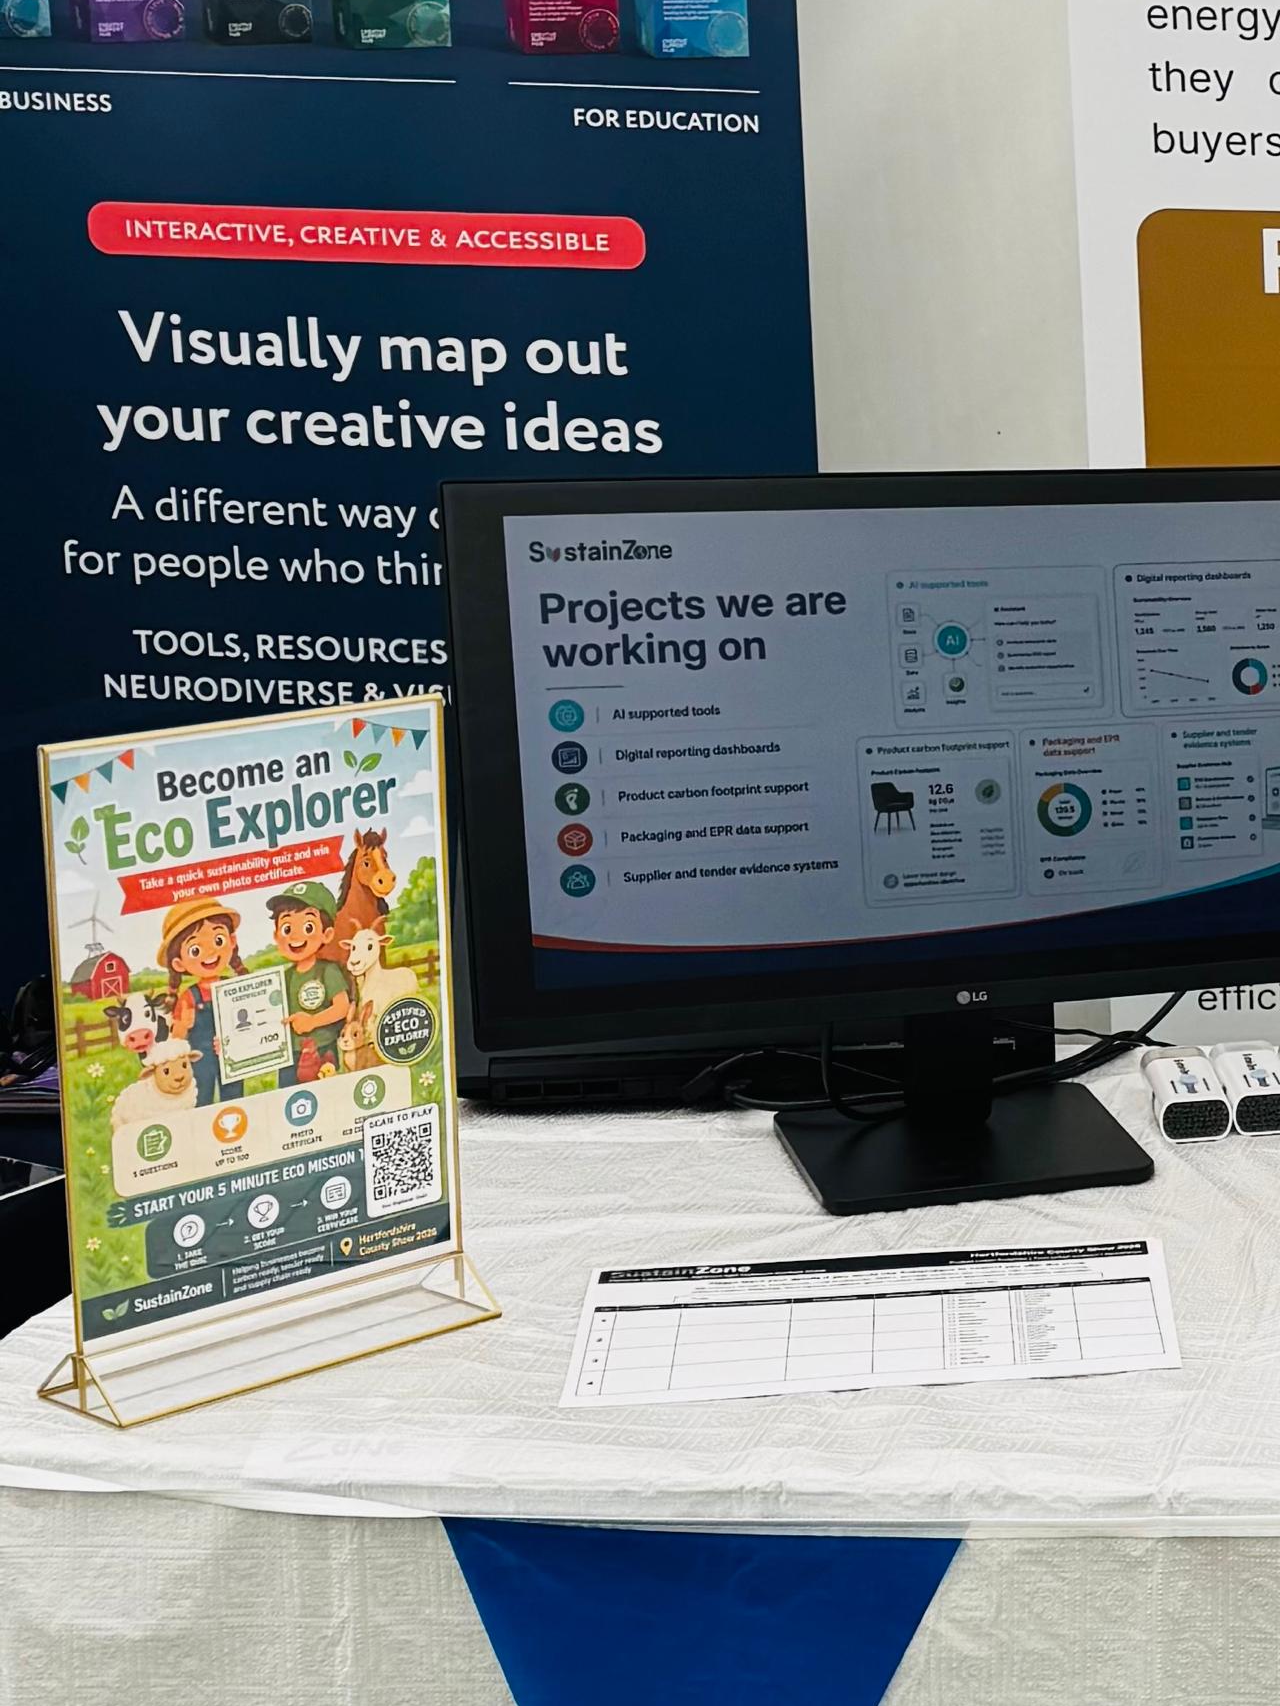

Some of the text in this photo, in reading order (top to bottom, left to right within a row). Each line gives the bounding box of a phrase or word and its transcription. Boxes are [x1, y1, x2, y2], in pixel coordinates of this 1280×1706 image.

[574, 108, 759, 133] FOR EDUCATION
[125, 219, 610, 252] INTERACTIVE, CREATIVE & ACCESSIBLE
[118, 310, 628, 385] Visually map out
[97, 398, 663, 453] your creative ideas
[112, 485, 416, 536] A different way
[539, 590, 846, 628] Projects we are
[133, 630, 448, 664] TOOLS, RESOURCES
[543, 634, 766, 669] working on
[104, 675, 352, 705] NEURODIVERSE
[613, 704, 720, 721] AI supported tools
[157, 751, 330, 801] Become an
[94, 776, 396, 869] Eco Explorer
[972, 992, 987, 1002] LG
[134, 1282, 213, 1312] SustainZone
